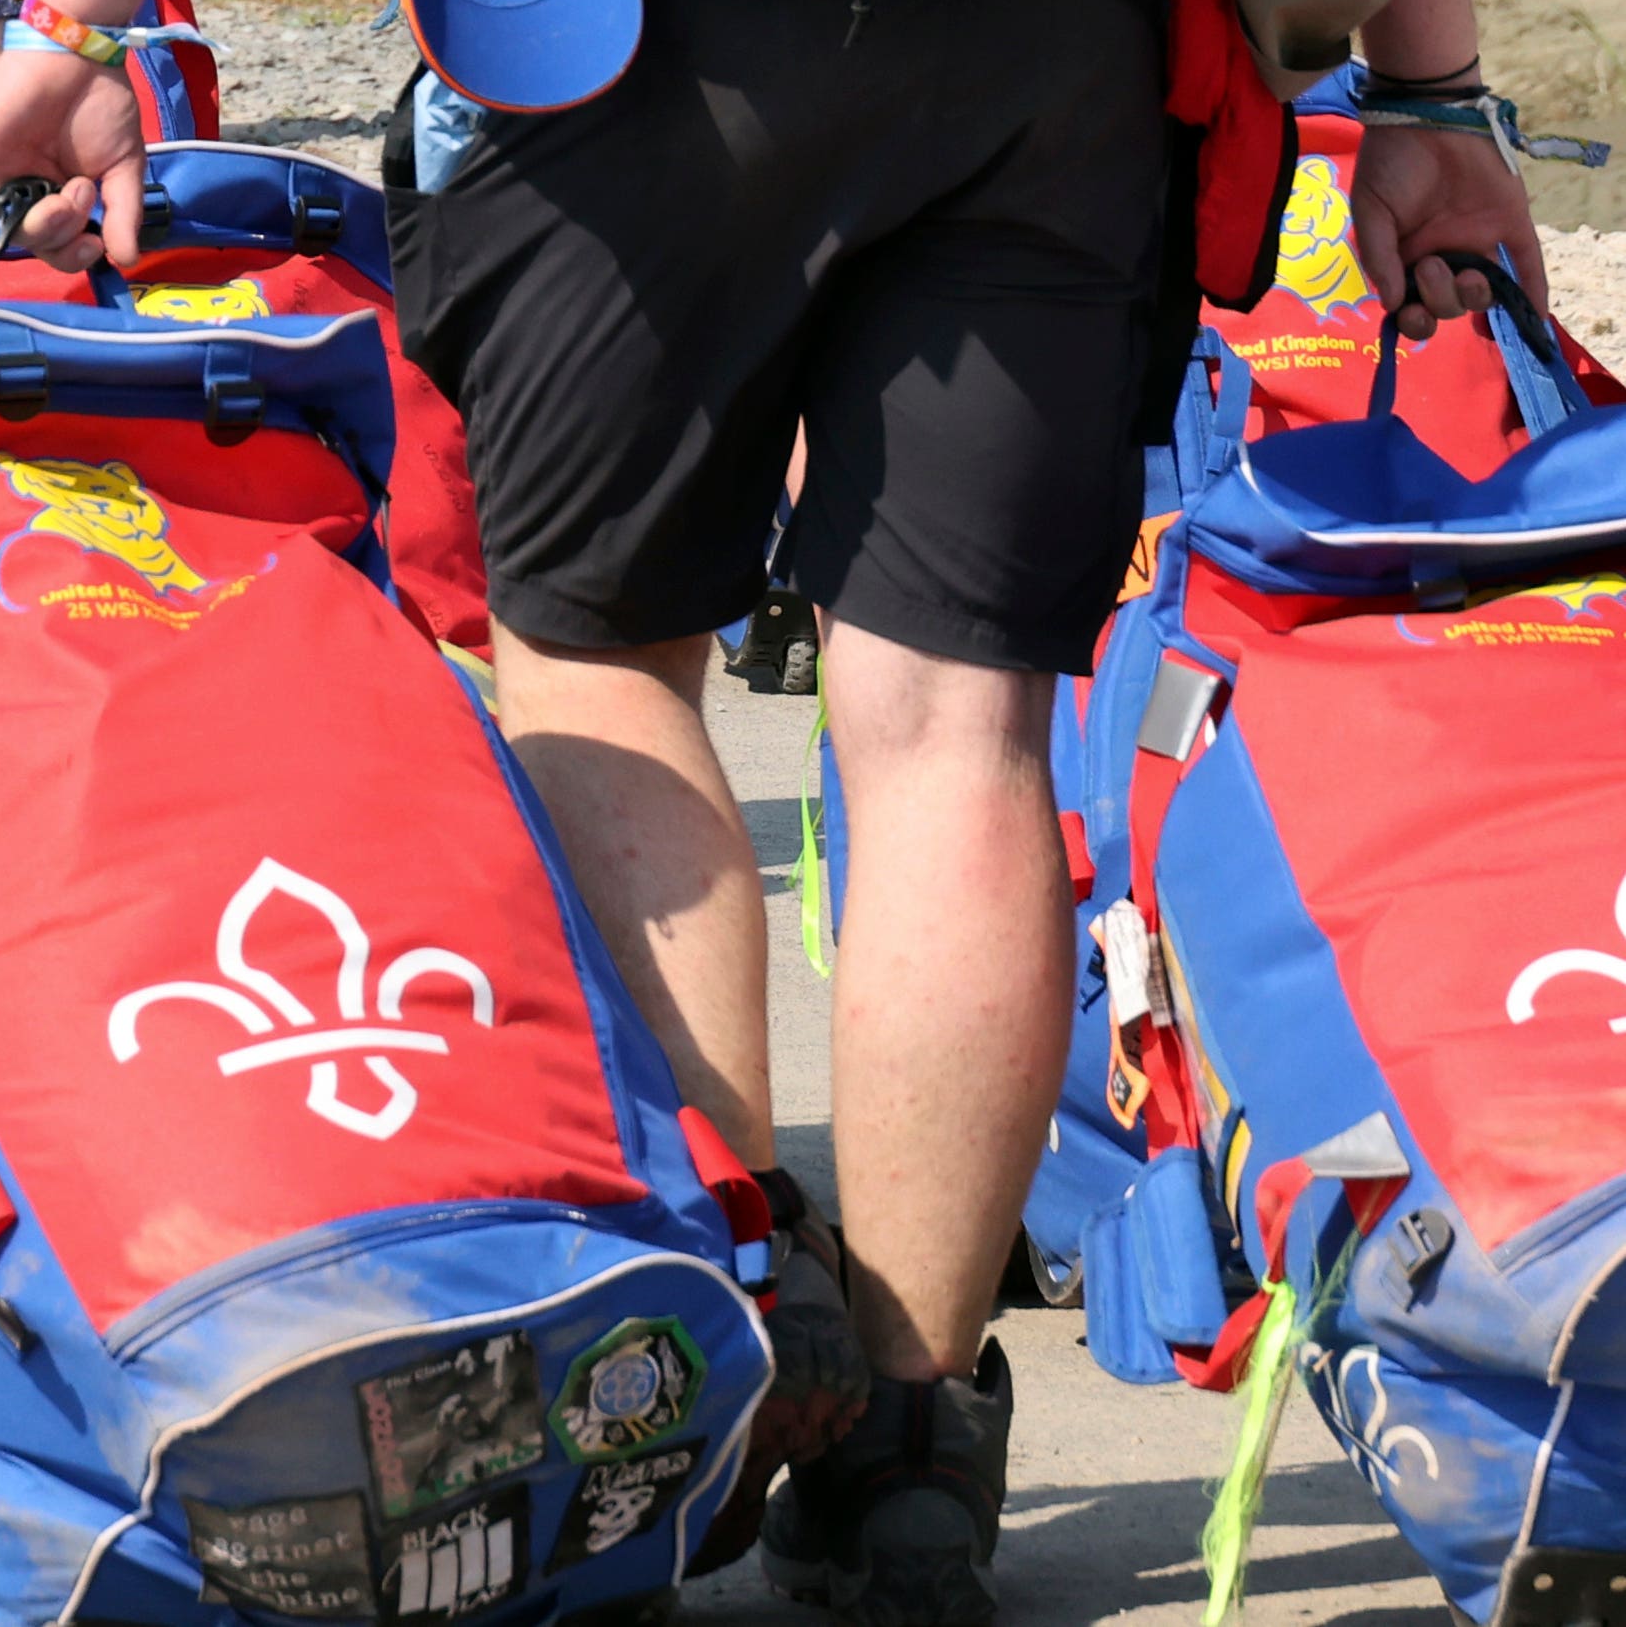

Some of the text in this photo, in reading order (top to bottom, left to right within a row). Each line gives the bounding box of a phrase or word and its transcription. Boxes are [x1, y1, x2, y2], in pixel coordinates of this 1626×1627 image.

[1272, 334, 1356, 354] Kingdom
[1251, 353, 1342, 372] WSJ Korea
[39, 581, 113, 606] United
[66, 601, 93, 620] 25
[94, 601, 140, 619] WSJ
[1444, 620, 1615, 641] United Kingdom
[1547, 633, 1602, 647] Korea
[402, 1502, 490, 1552] BLACK
